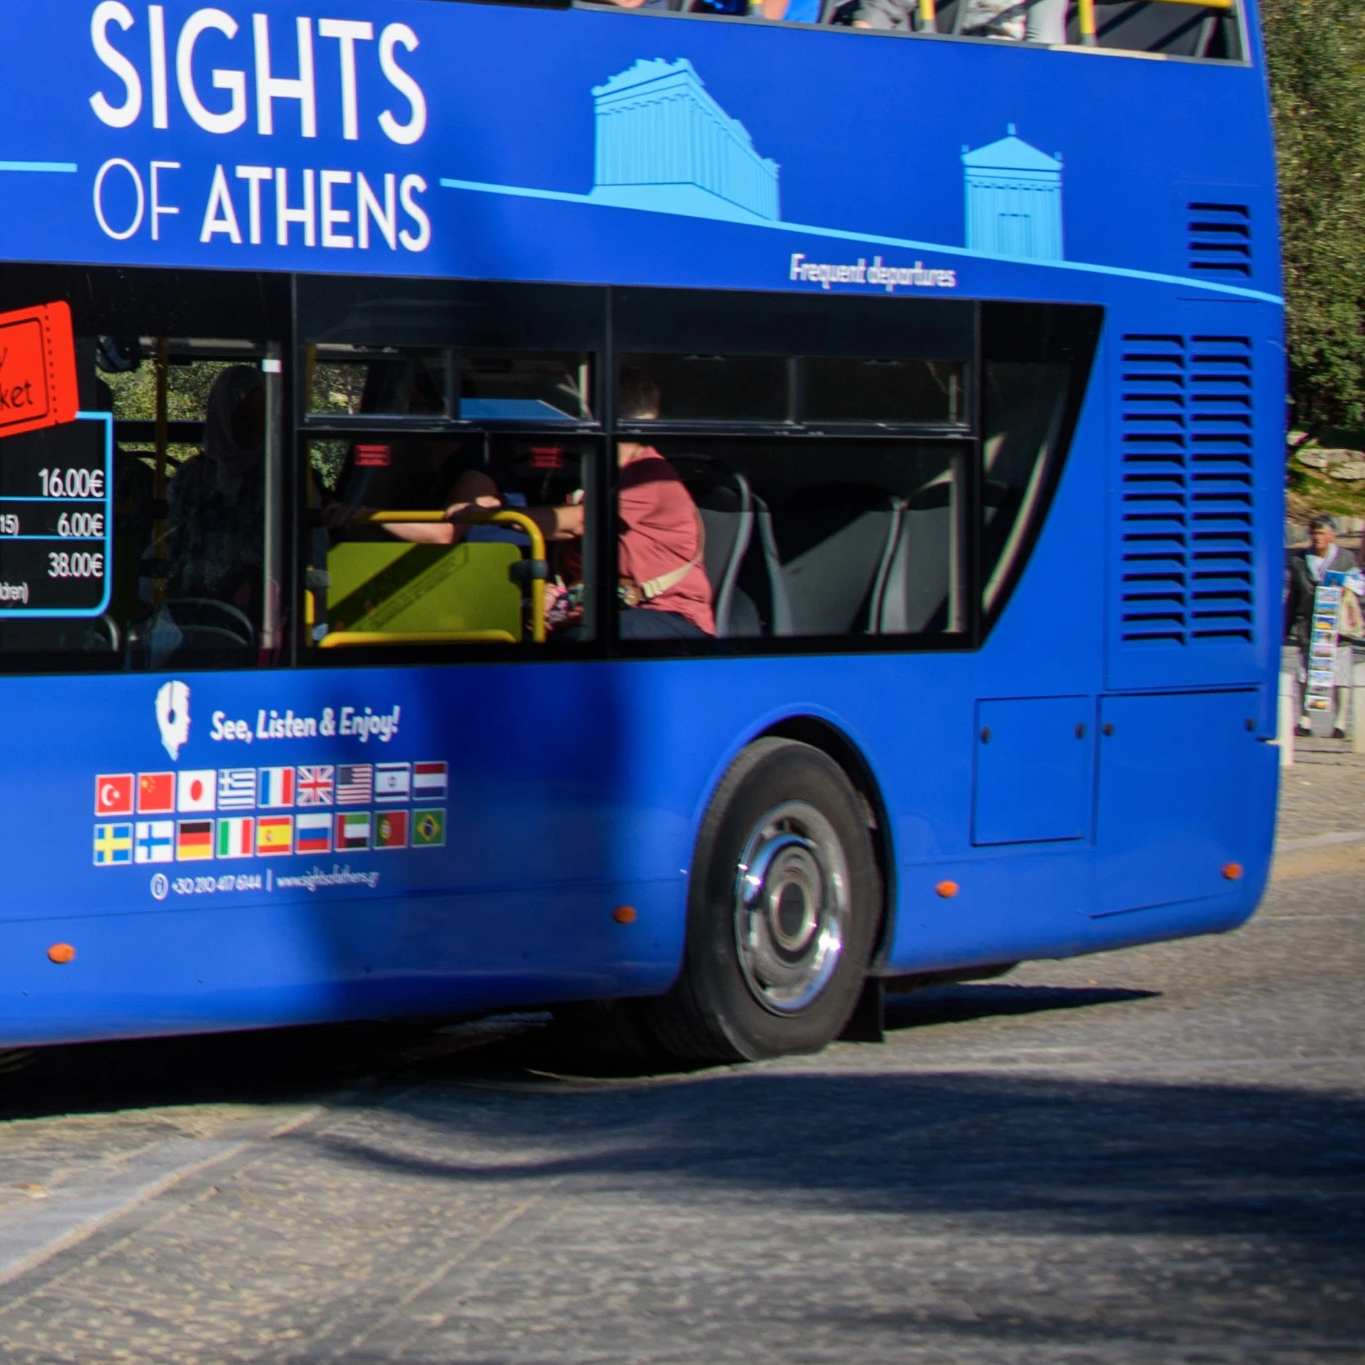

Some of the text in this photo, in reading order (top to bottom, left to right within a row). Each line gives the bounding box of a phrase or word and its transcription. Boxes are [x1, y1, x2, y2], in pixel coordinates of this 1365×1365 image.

[89, 0, 427, 145] SIGHTS
[93, 158, 431, 252] OF ATHENS
[789, 253, 956, 292] Frequent departures
[38, 468, 104, 497] 16.00€
[57, 512, 104, 537] 6.00€
[48, 552, 104, 577] 38.00€
[210, 705, 401, 744] See, Listen & Enjoy!
